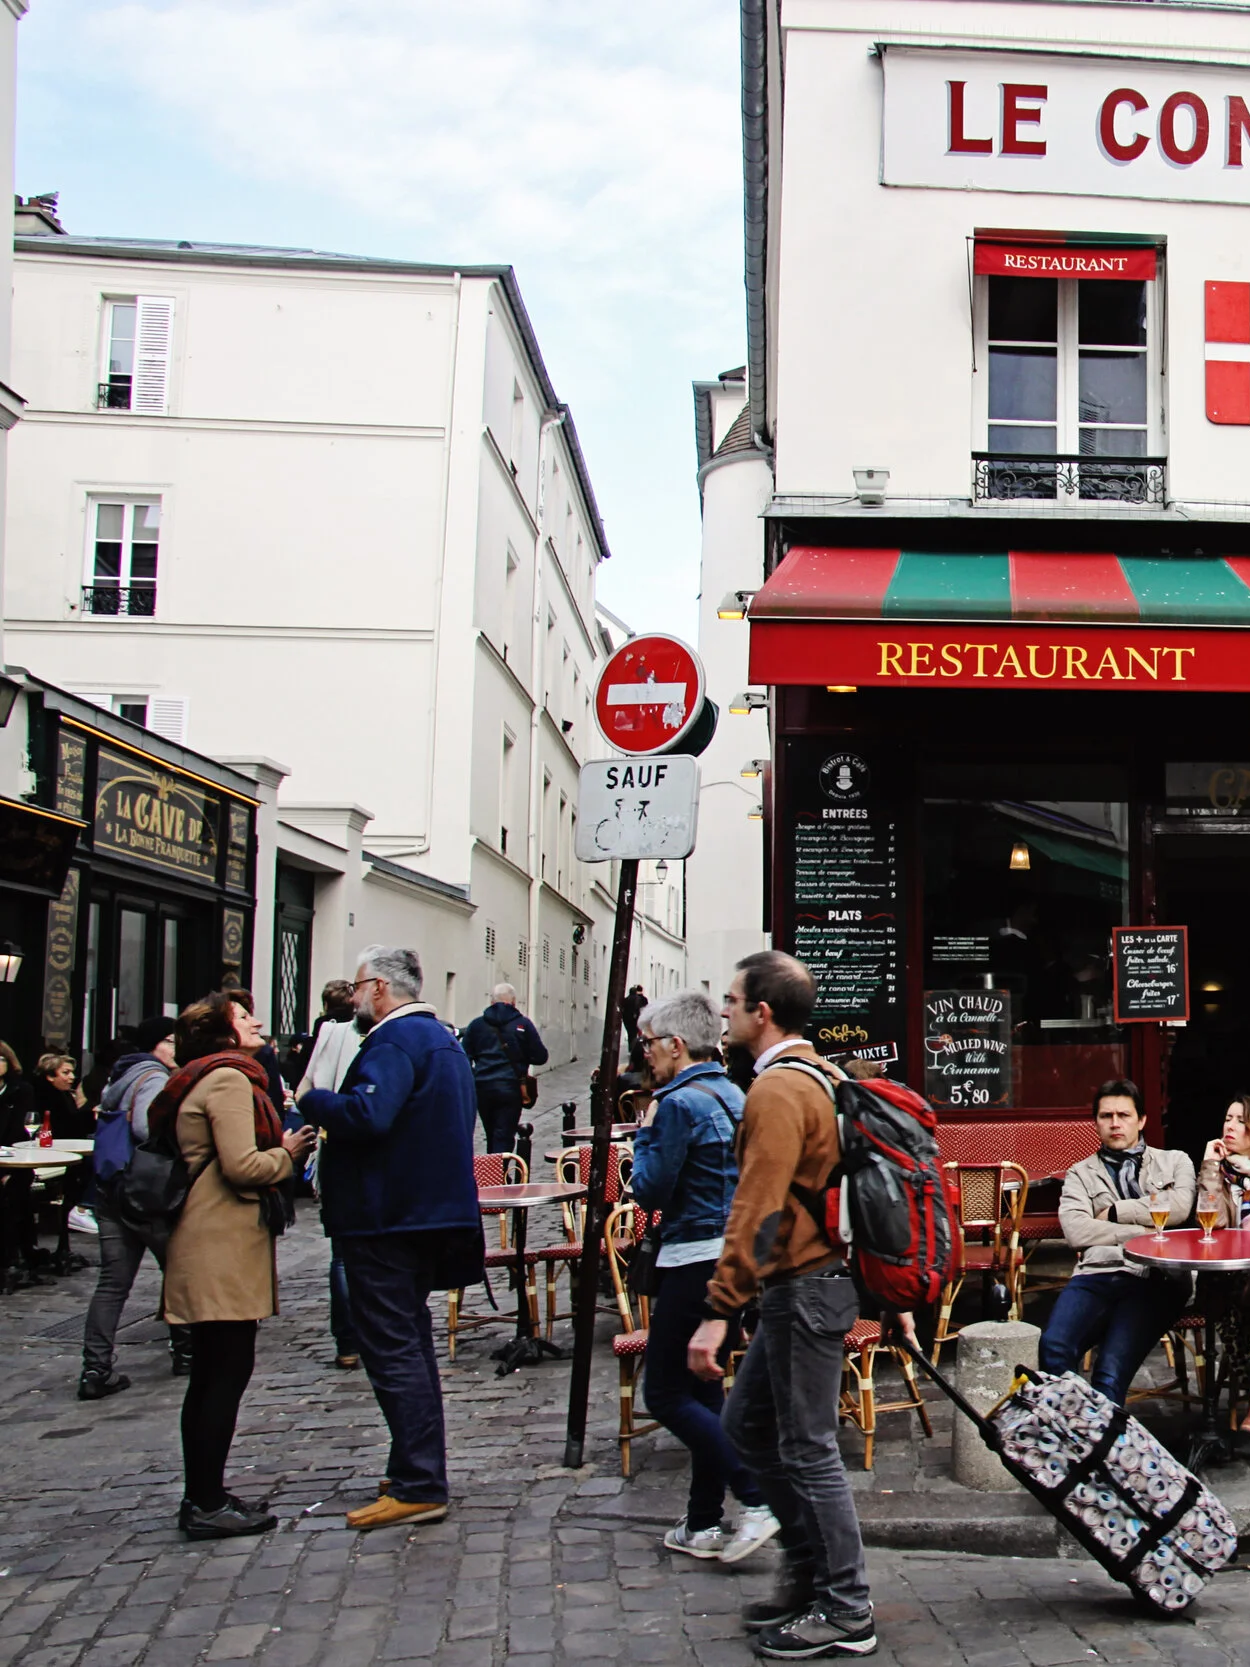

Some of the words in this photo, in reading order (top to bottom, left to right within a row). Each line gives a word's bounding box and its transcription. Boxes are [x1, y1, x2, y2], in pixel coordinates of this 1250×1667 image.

[944, 80, 1048, 156] LE
[1004, 254, 1128, 271] RESTAURANT
[876, 642, 1195, 681] RESTAURANT
[606, 764, 668, 790] SAUF
[117, 791, 131, 819] LA
[134, 793, 185, 843] CAVE
[188, 818, 203, 844] DE
[822, 808, 868, 818] ENTRÉES
[828, 911, 862, 920] PLATS
[927, 998, 953, 1016] VIN
[959, 996, 1002, 1013] CHAUD
[947, 1012, 957, 1022] la
[853, 1046, 888, 1059] MIXTE
[943, 1039, 981, 1055] MULLED
[983, 1039, 1007, 1054] WINE
[965, 1052, 986, 1063] With
[942, 1063, 1000, 1075] Cinnamon
